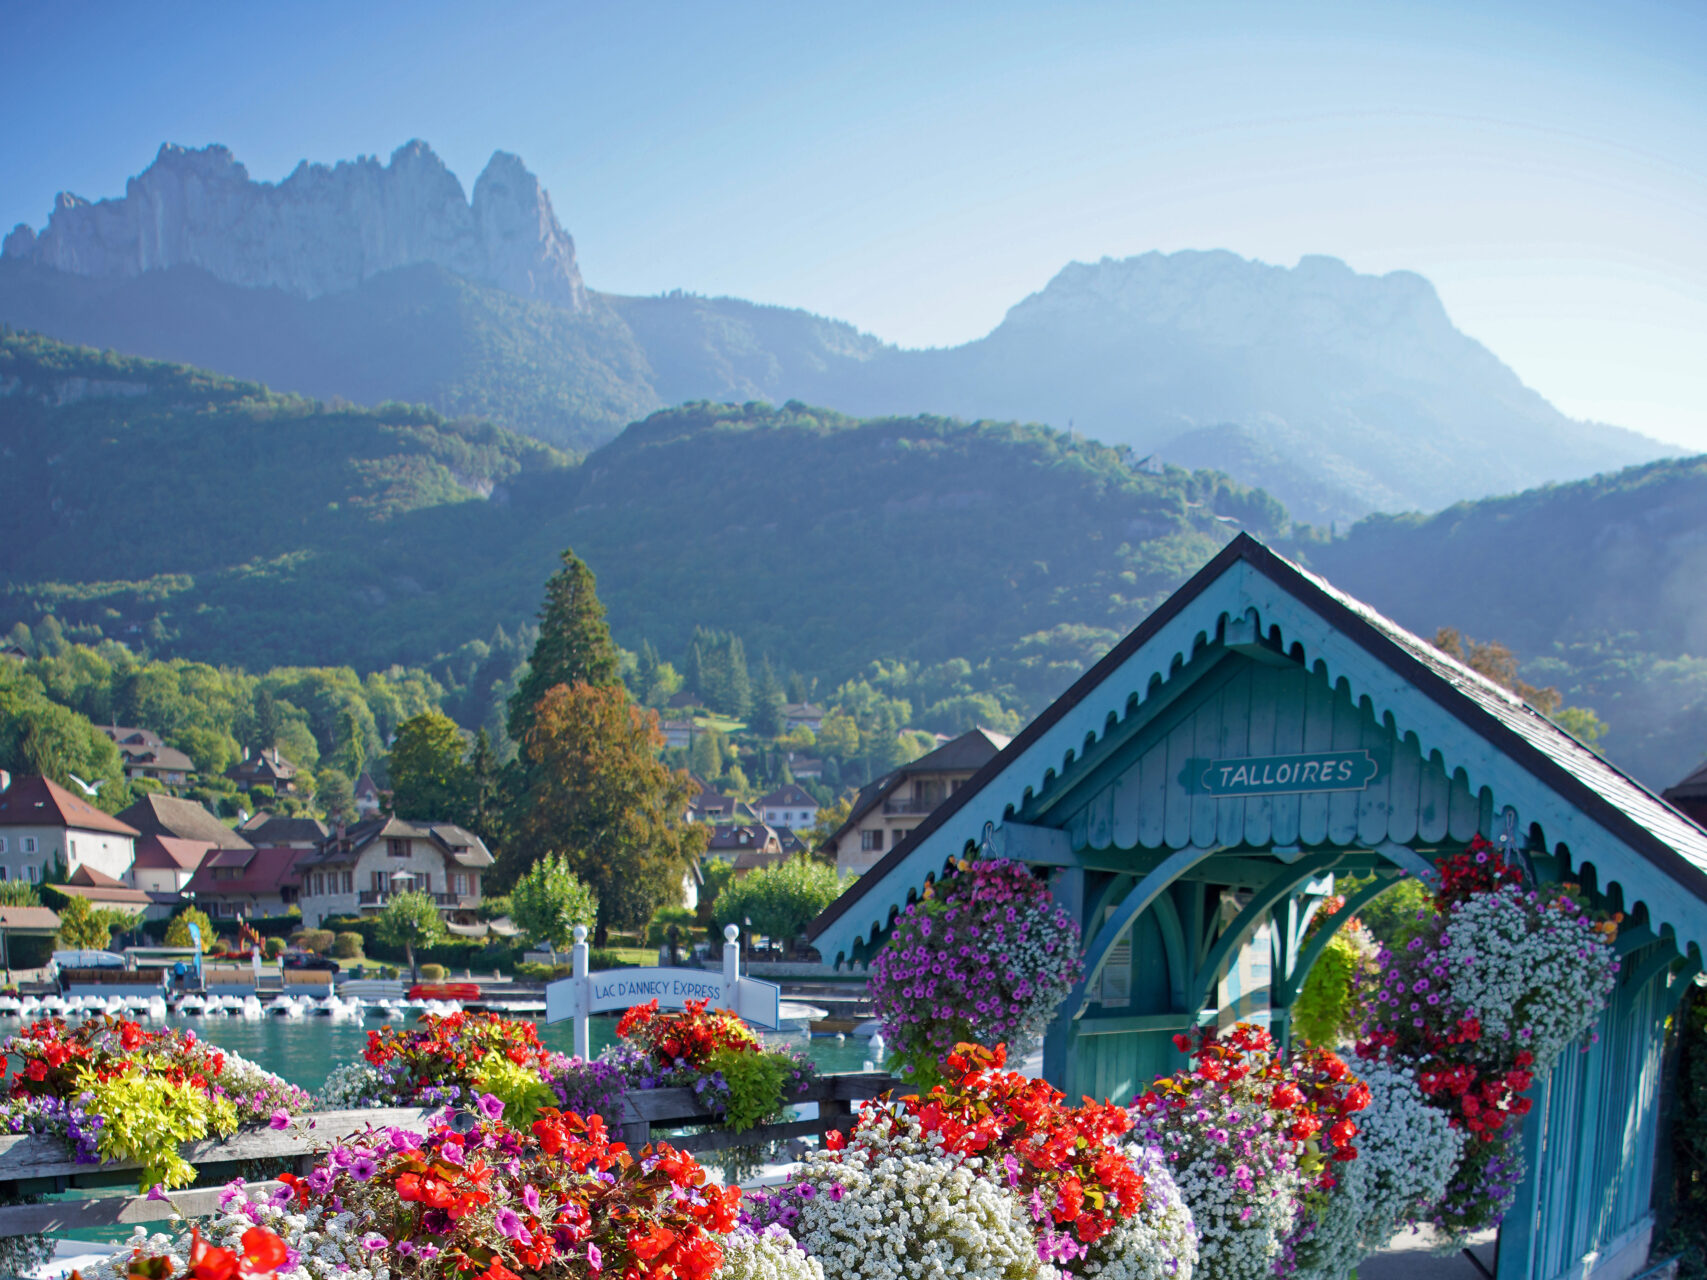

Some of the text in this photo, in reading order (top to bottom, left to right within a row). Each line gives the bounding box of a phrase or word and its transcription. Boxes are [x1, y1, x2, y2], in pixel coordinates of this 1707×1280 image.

[1220, 761, 1353, 787] TALLOIRES
[595, 980, 720, 1000] LAC D'ANNECY EXPRESS
